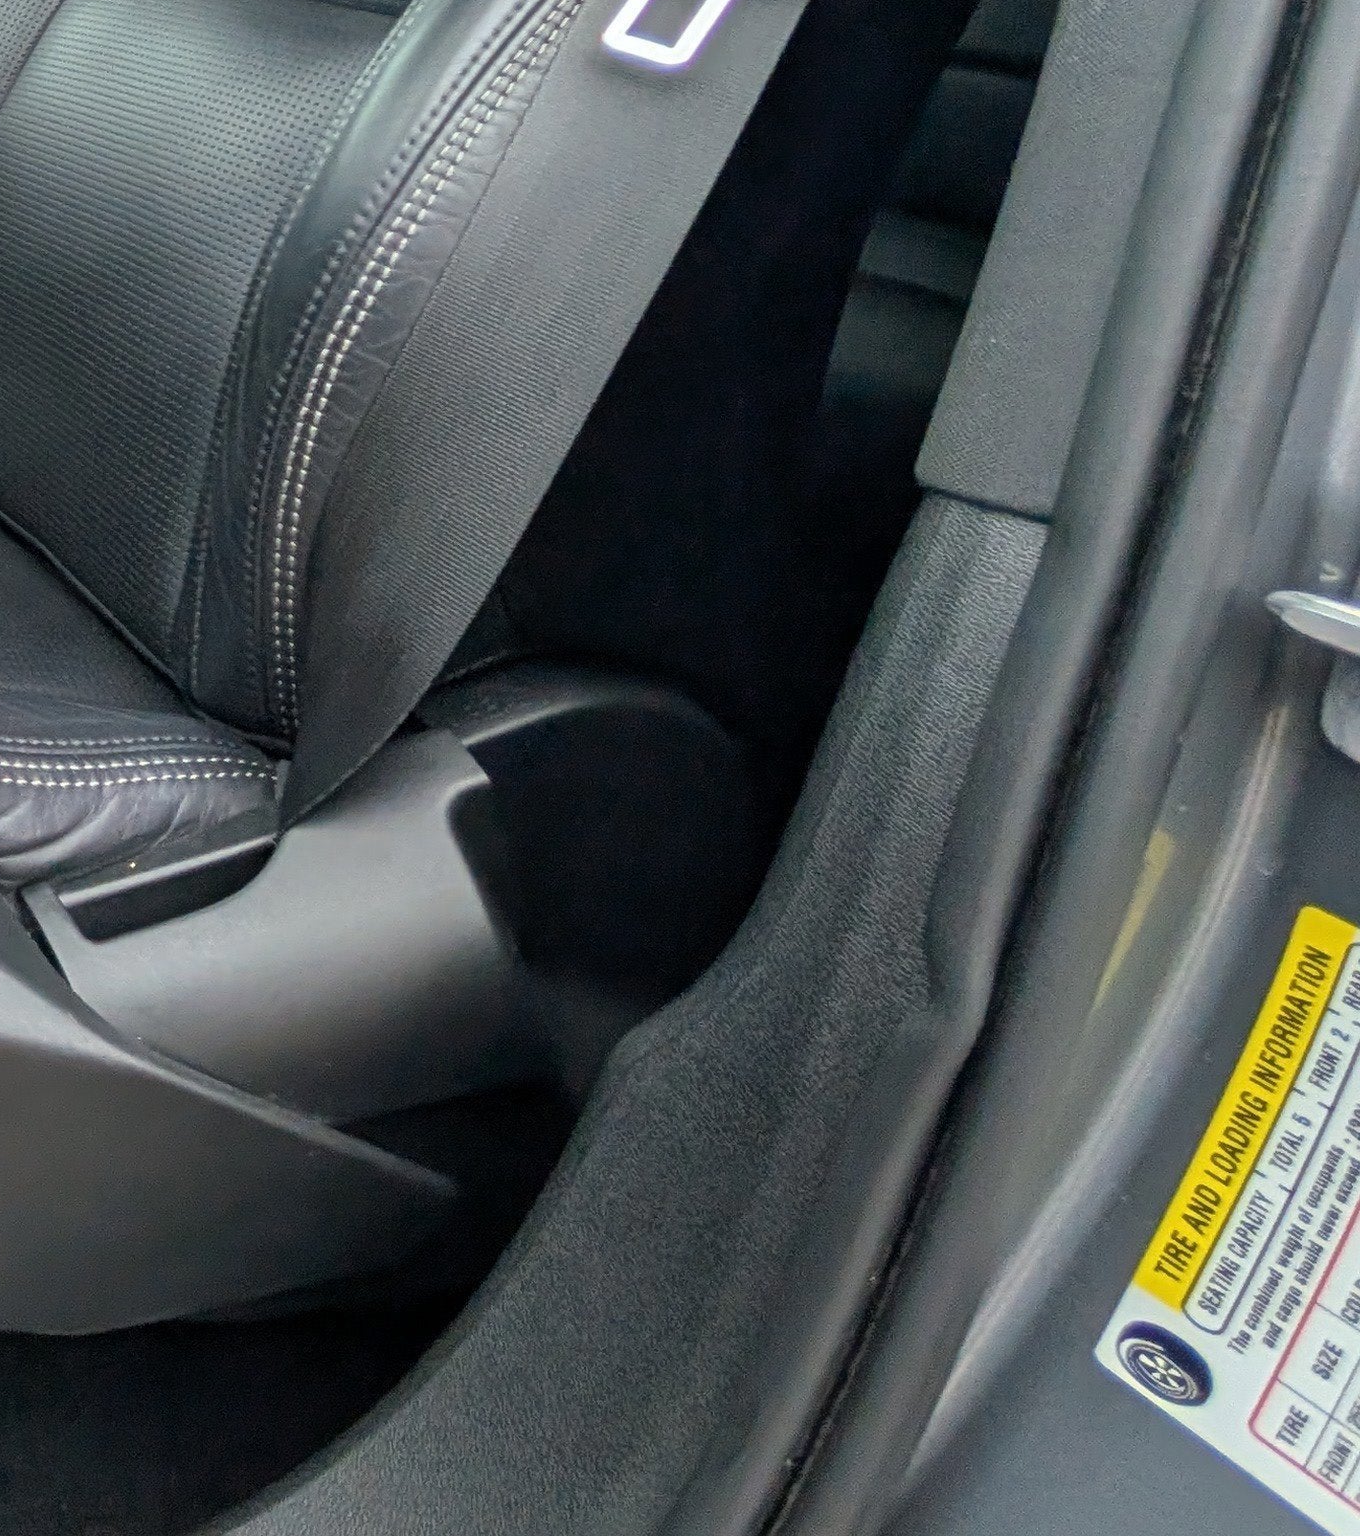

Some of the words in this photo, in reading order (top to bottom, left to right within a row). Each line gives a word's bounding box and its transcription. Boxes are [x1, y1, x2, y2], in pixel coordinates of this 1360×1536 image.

[1154, 1230, 1198, 1282] TIRE
[1181, 1184, 1221, 1236] AND
[1204, 1090, 1269, 1187] LOADING
[1249, 944, 1332, 1093] INFORMATION
[1309, 1041, 1343, 1091] FRONT
[1270, 1130, 1305, 1172] TOTAL
[1198, 1256, 1241, 1315] SEATING
[1227, 1190, 1273, 1258] CAPACITY
[1227, 1330, 1251, 1355] The
[1245, 1266, 1284, 1331] combined
[1276, 1225, 1306, 1268] weight
[1298, 1205, 1313, 1225] of
[1306, 1144, 1345, 1208] occupants
[1262, 1320, 1284, 1349] and
[1275, 1286, 1302, 1322] cargo
[1294, 1239, 1324, 1286] should
[1317, 1203, 1343, 1241] never
[1275, 1405, 1310, 1446] TIRE
[1311, 1339, 1345, 1381] SIZE
[1318, 1431, 1356, 1485] FRONT
